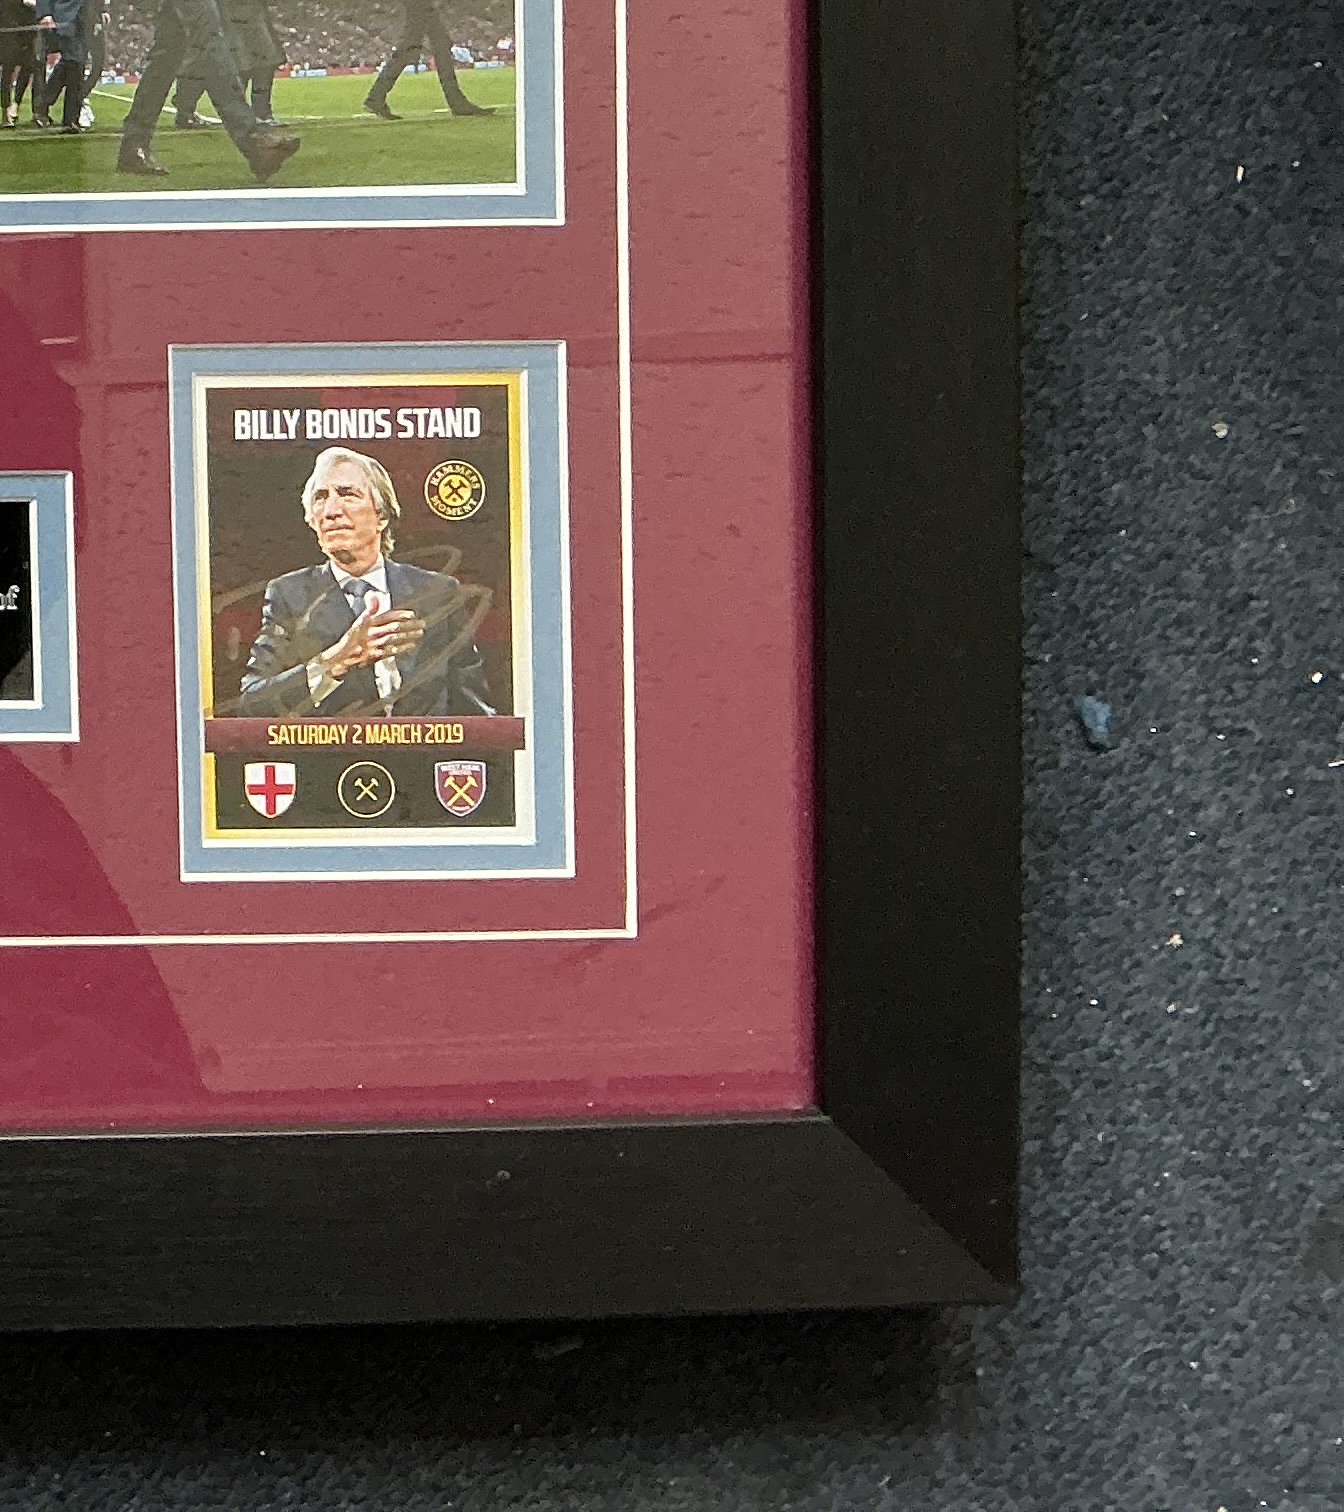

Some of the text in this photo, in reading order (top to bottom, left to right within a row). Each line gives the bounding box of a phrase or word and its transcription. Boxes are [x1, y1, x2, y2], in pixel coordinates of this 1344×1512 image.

[234, 406, 482, 441] BILLY BONDS STAND
[430, 464, 481, 490] HAMMERS
[430, 495, 478, 517] MOMENT
[267, 722, 464, 746] SATURDAY 2 MARCH 2019
